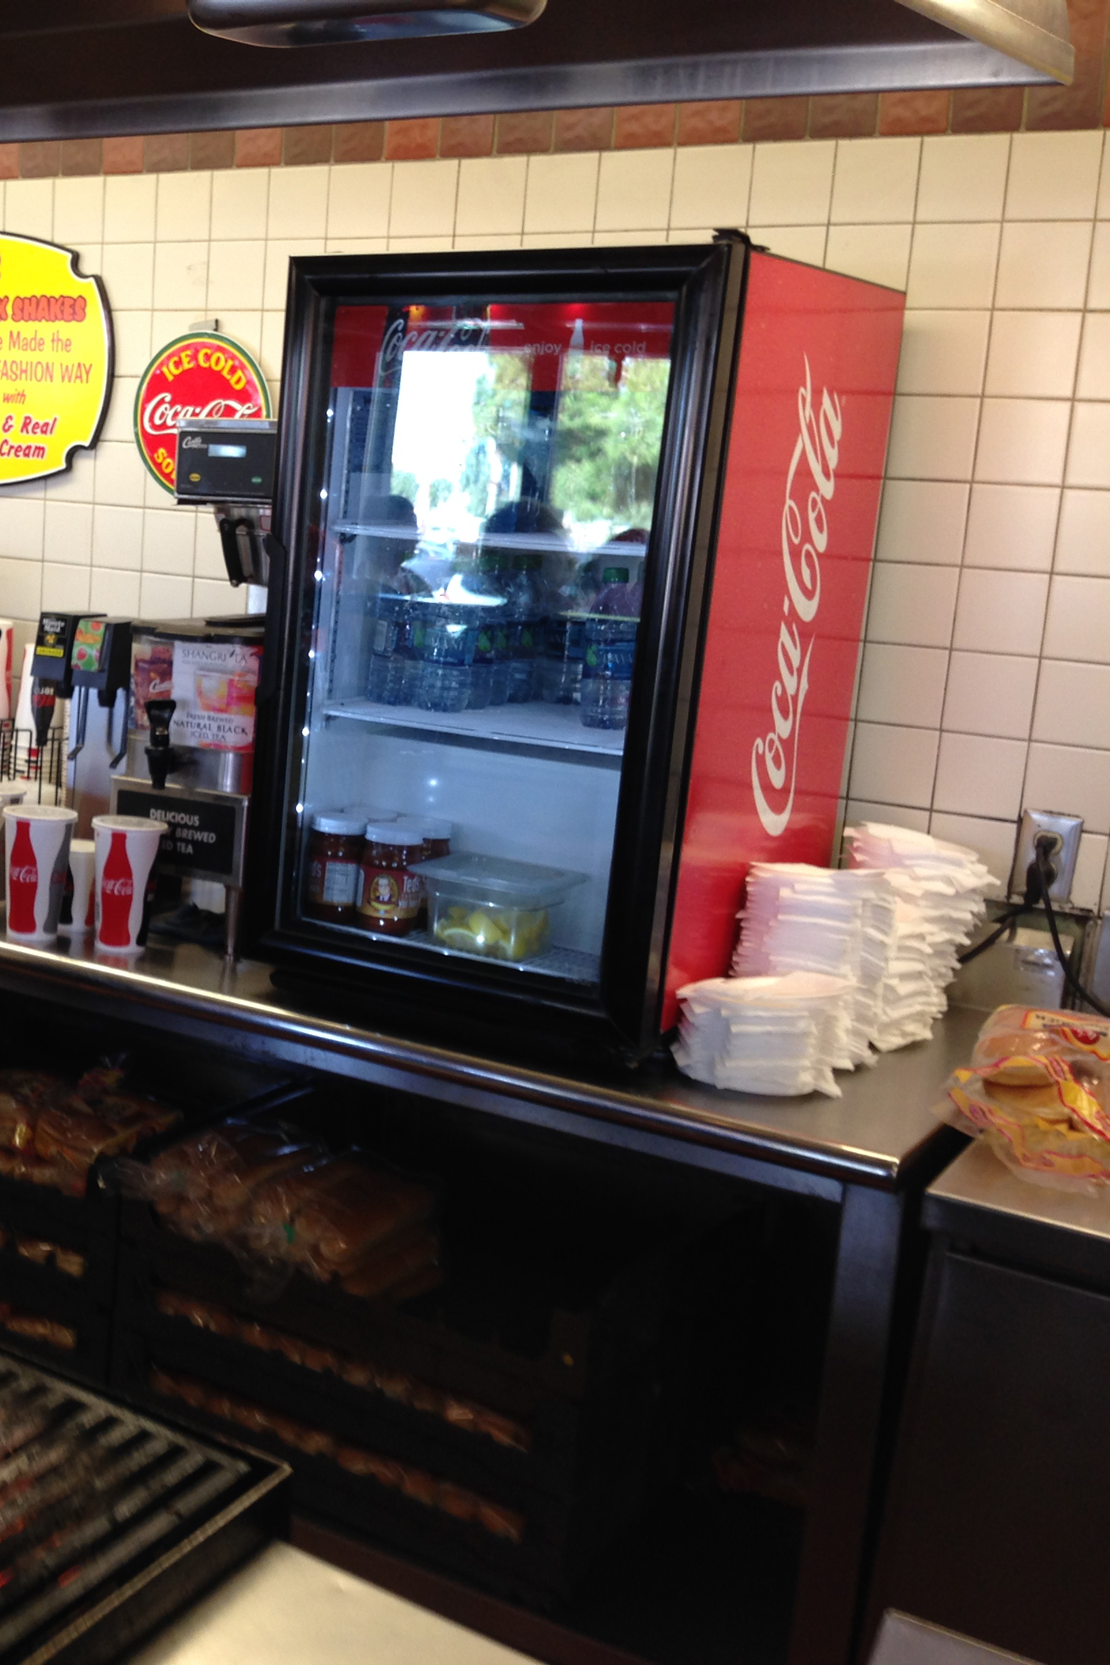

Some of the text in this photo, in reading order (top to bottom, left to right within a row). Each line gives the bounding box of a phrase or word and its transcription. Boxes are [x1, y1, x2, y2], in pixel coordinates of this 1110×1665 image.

[11, 295, 87, 322] SHAKES
[8, 330, 45, 352] Made
[51, 329, 72, 353] the
[524, 341, 647, 355] enjoy ice cold
[60, 362, 93, 384] WAY
[161, 348, 247, 391] ICE COLD
[2, 388, 27, 405] with
[2, 414, 14, 433] &
[20, 415, 58, 435] Real
[751, 351, 843, 837] Coca-Cola
[173, 720, 248, 736] NATURAL BLACK
[150, 808, 200, 826] DELICIOUS
[175, 827, 216, 843] BREWED
[177, 842, 193, 854] TEA
